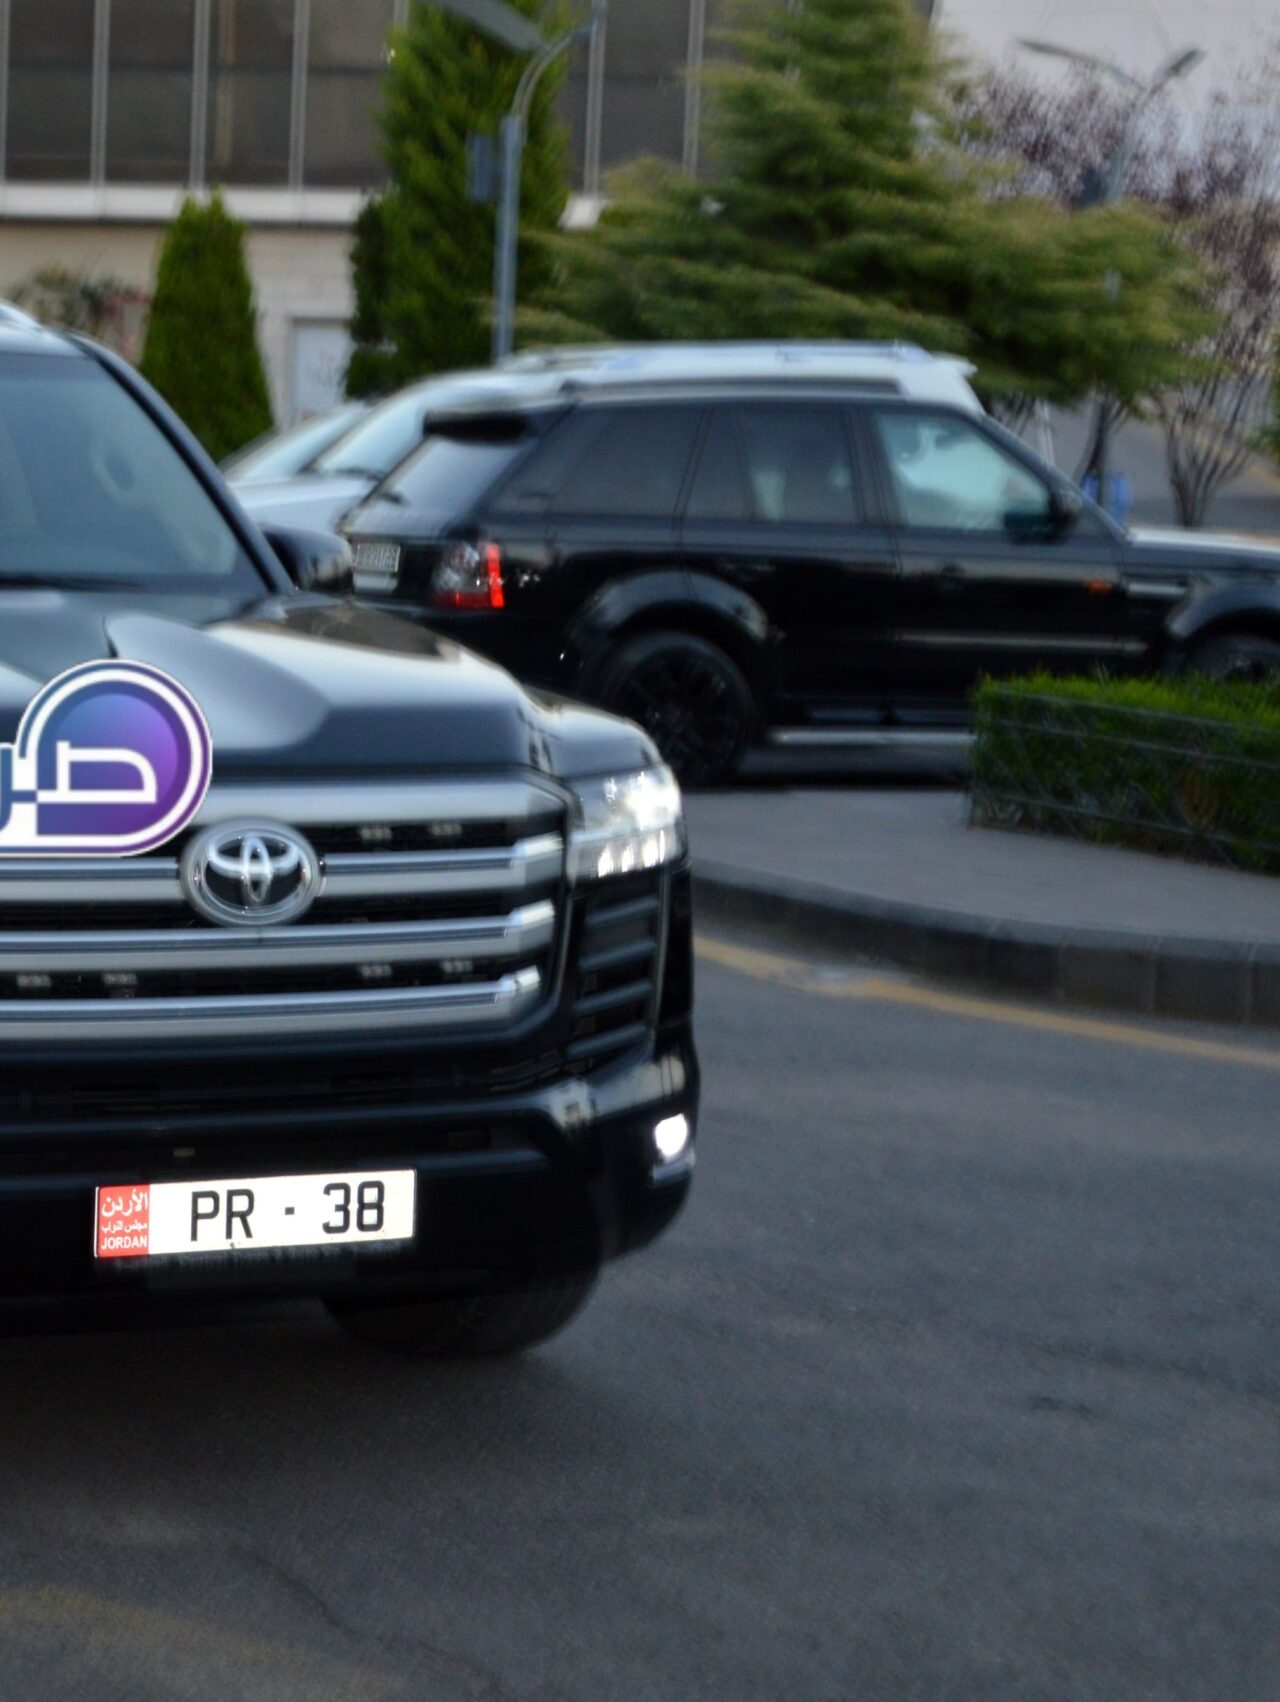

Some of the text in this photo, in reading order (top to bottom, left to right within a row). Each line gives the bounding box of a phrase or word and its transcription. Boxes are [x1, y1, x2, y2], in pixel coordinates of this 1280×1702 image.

[190, 1188, 255, 1242] PR
[322, 1180, 385, 1234] 38
[101, 1235, 148, 1250] JORDAN
